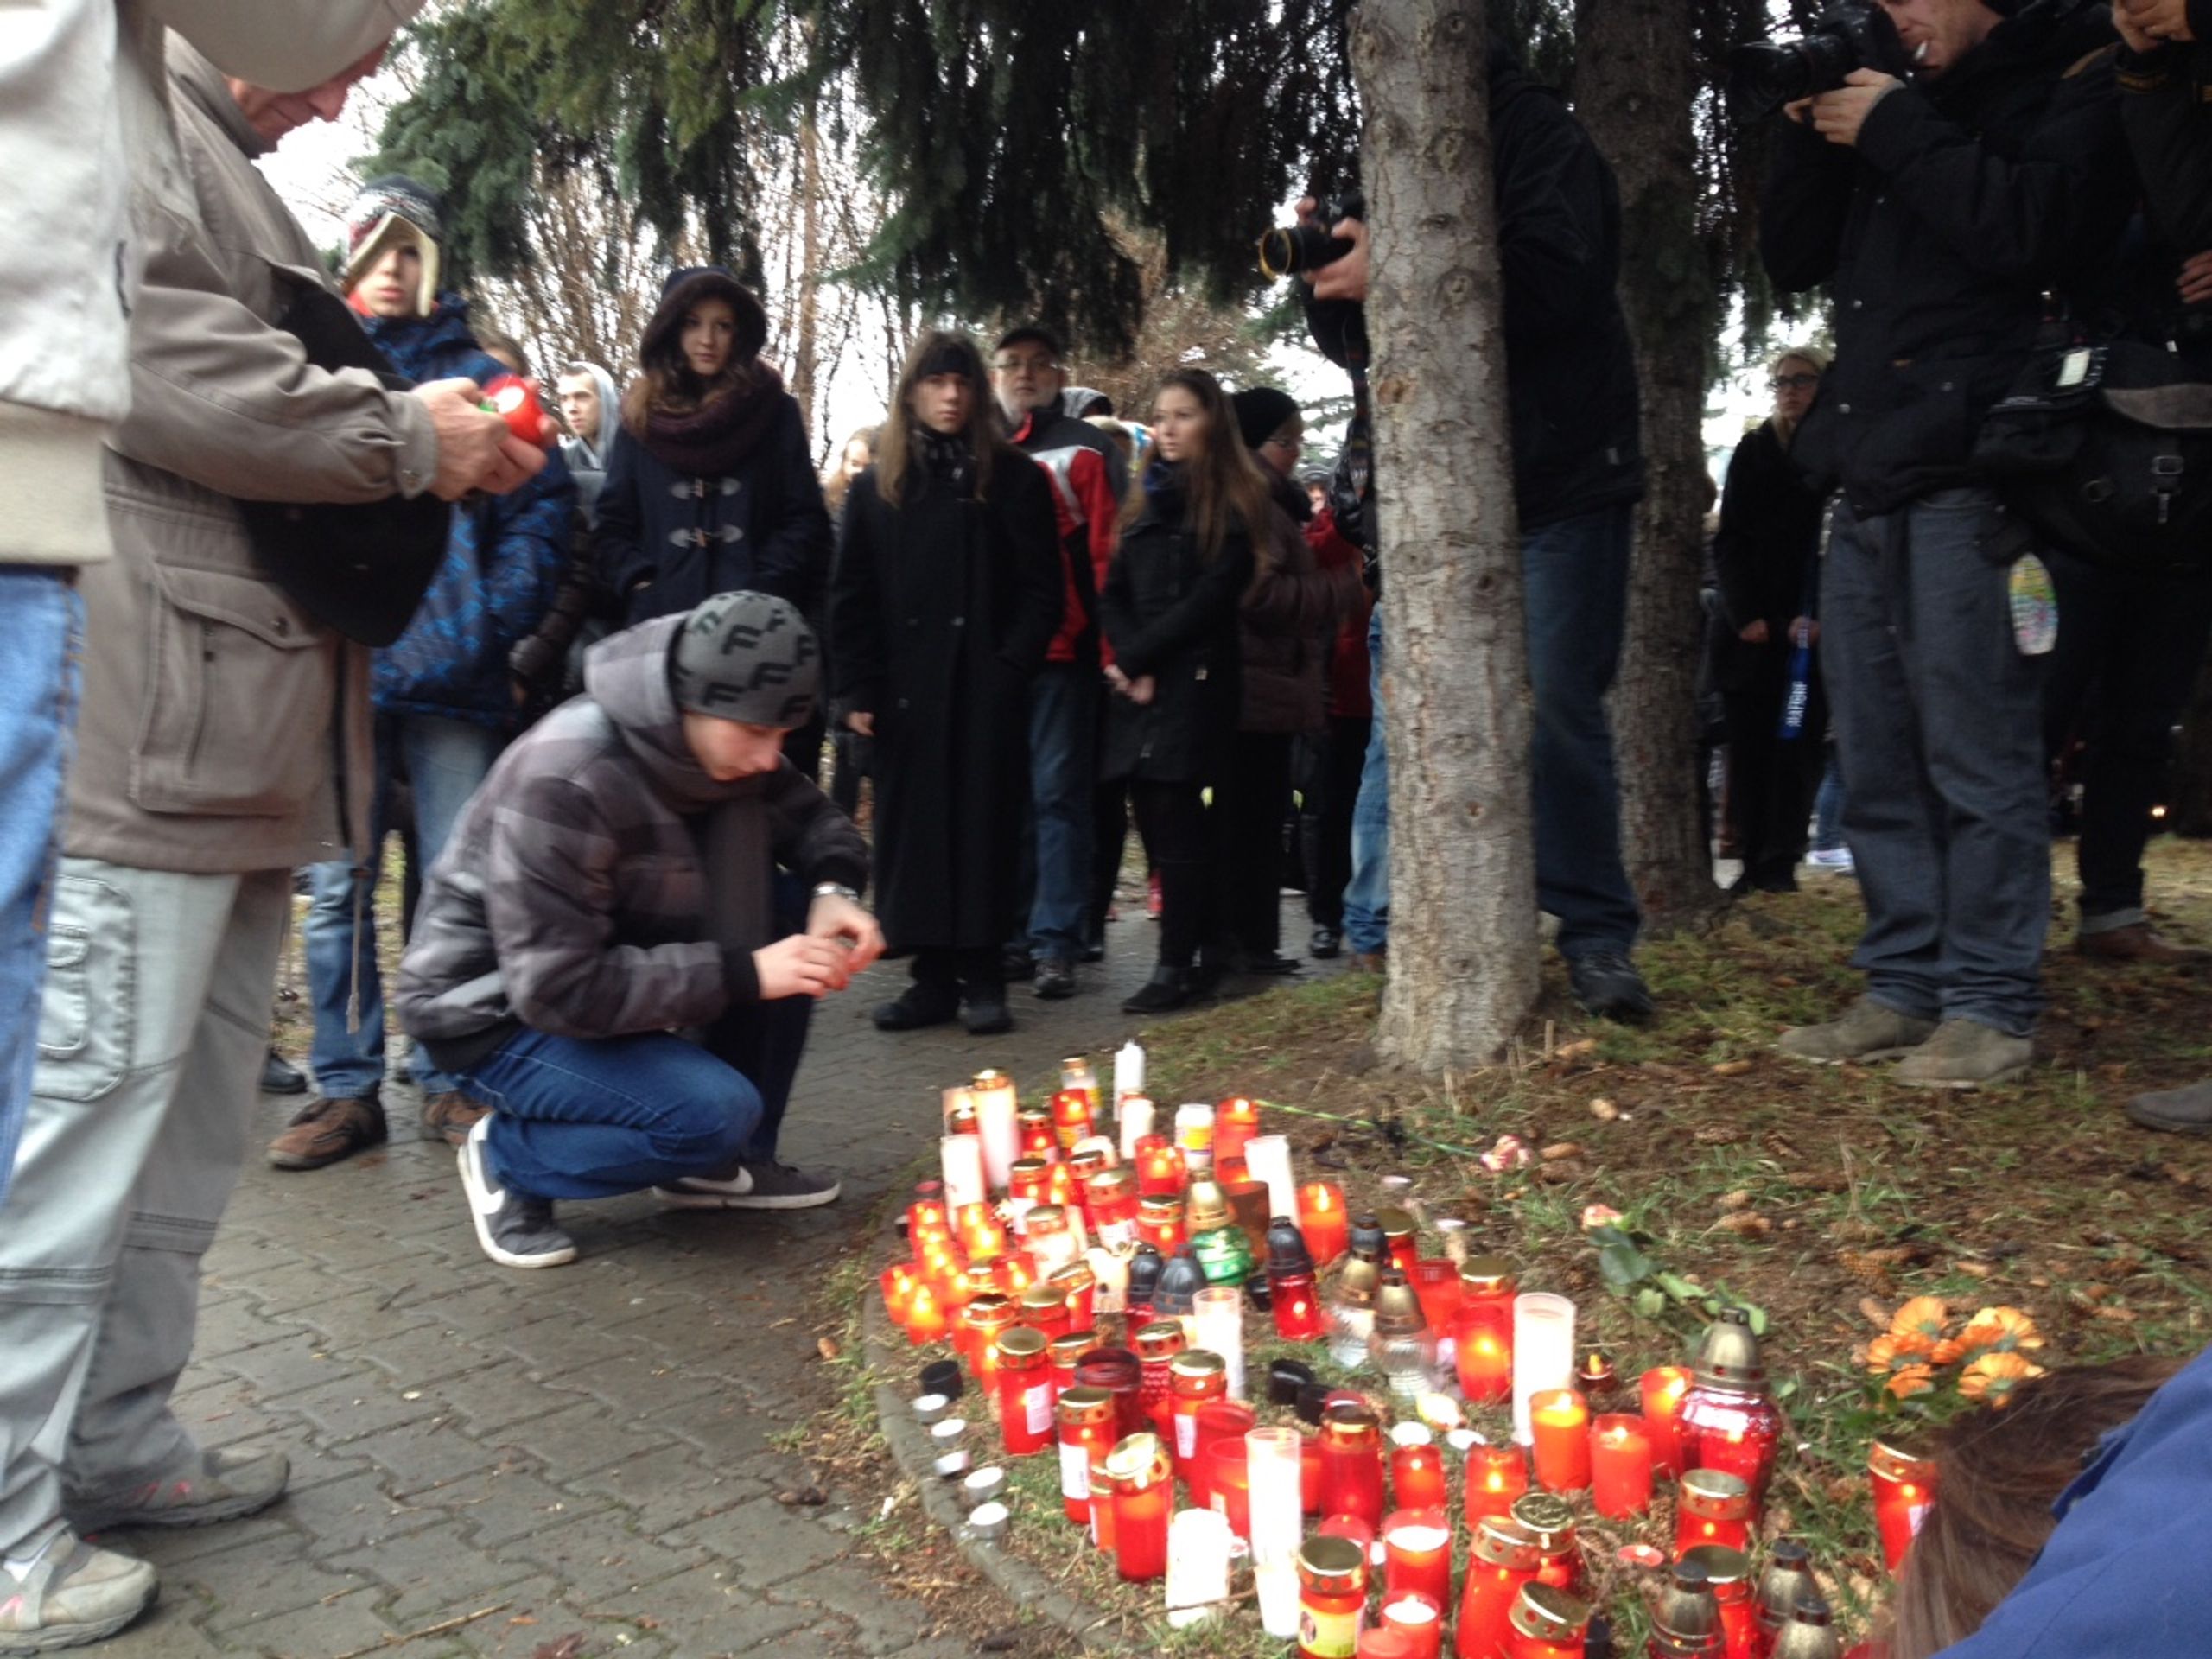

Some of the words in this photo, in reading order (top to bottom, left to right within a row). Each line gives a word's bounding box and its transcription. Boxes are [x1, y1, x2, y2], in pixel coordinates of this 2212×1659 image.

[721, 624, 762, 655] F
[749, 663, 794, 690] F
[702, 682, 745, 707] F
